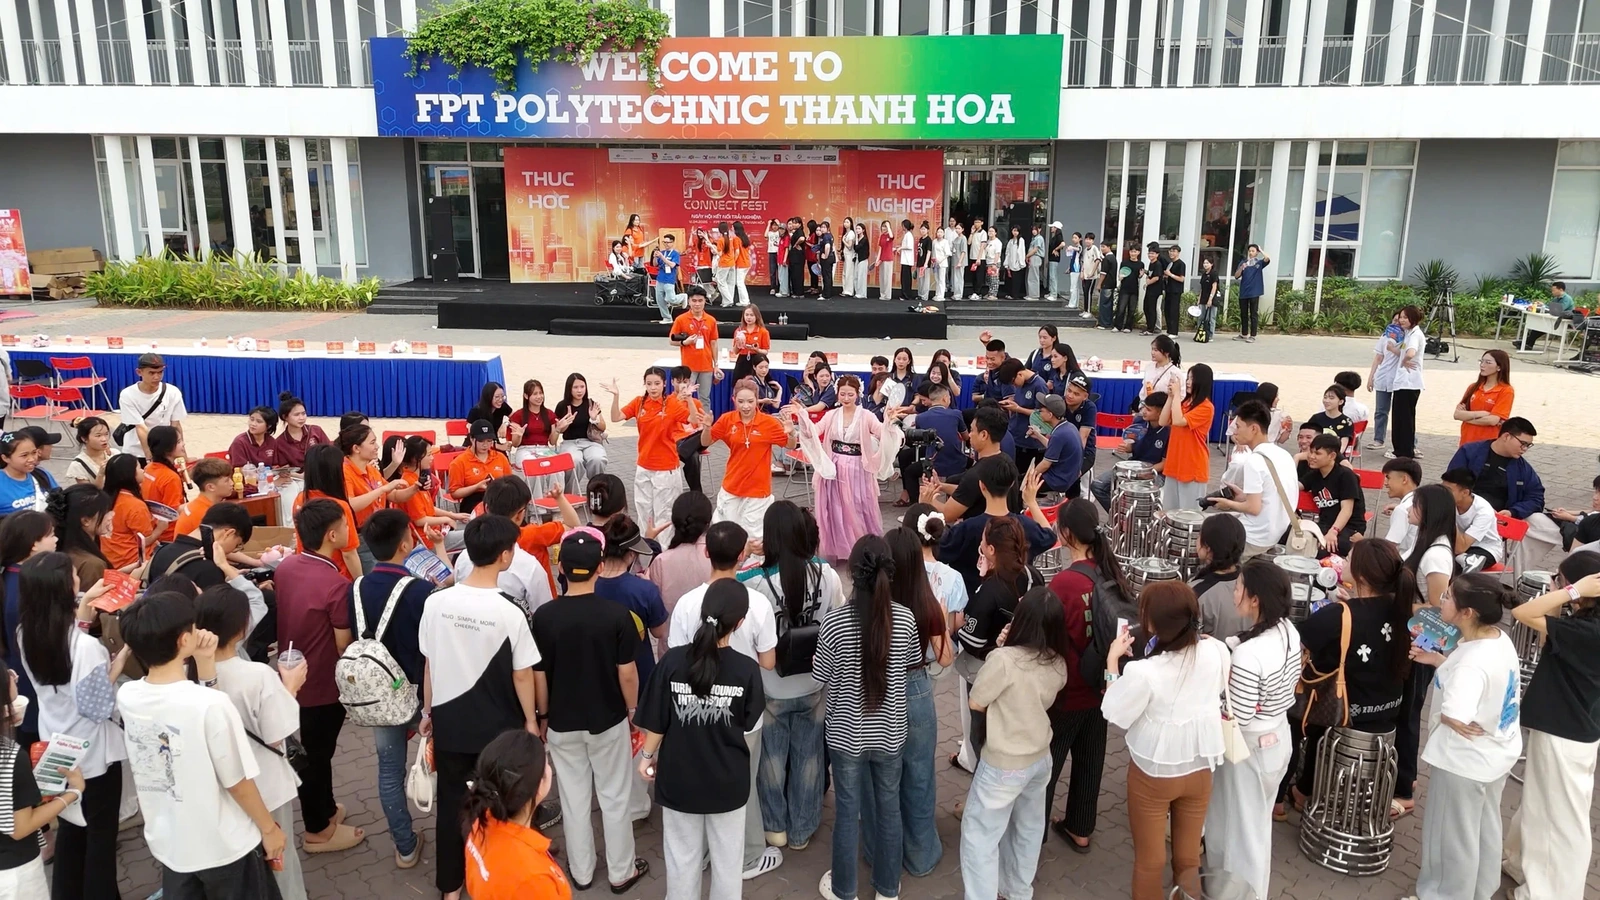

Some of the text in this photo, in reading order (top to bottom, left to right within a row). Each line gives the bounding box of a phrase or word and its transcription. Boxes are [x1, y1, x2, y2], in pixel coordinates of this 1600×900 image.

[577, 51, 842, 82] WELCOME TO
[415, 93, 1015, 125] FPT POLYTECHNIC THANH HOA
[521, 171, 575, 187] THUC
[683, 169, 769, 199] POLY
[877, 174, 926, 190] THUC
[683, 200, 768, 211] CONNECT FEST
[454, 622, 481, 632] CHEERFUL
[457, 615, 476, 624] SIMPLE
